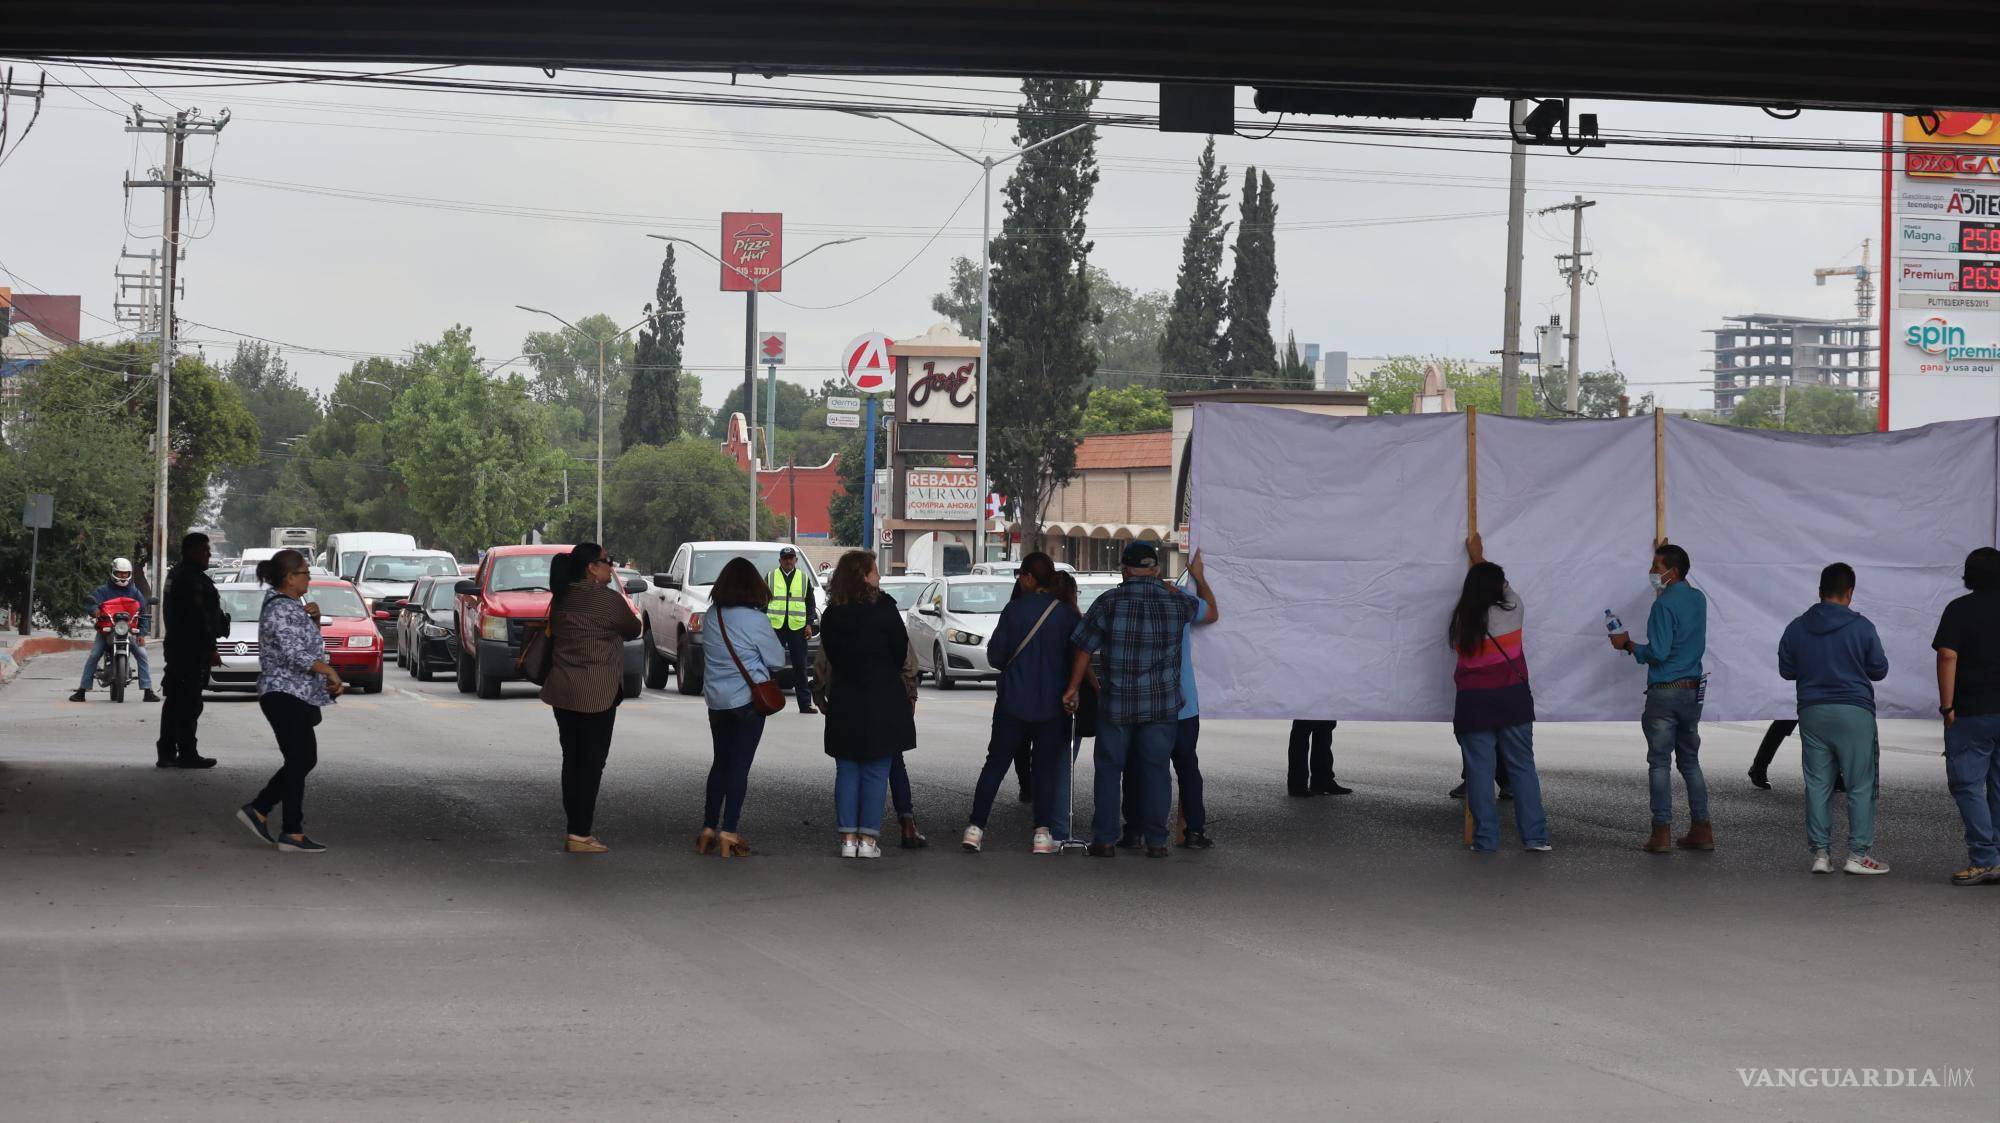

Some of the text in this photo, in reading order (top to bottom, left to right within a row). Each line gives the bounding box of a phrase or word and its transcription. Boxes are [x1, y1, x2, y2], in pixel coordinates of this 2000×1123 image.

[1904, 229, 1941, 243] Magna
[733, 238, 770, 255] Pizza
[740, 249, 768, 264] Hut
[1904, 268, 1954, 279] Premium
[1908, 320, 1965, 349] spin
[1920, 364, 1943, 373] gana
[1953, 364, 1969, 372] usa
[909, 473, 977, 487] REBAJAS
[918, 487, 977, 499] VERANO
